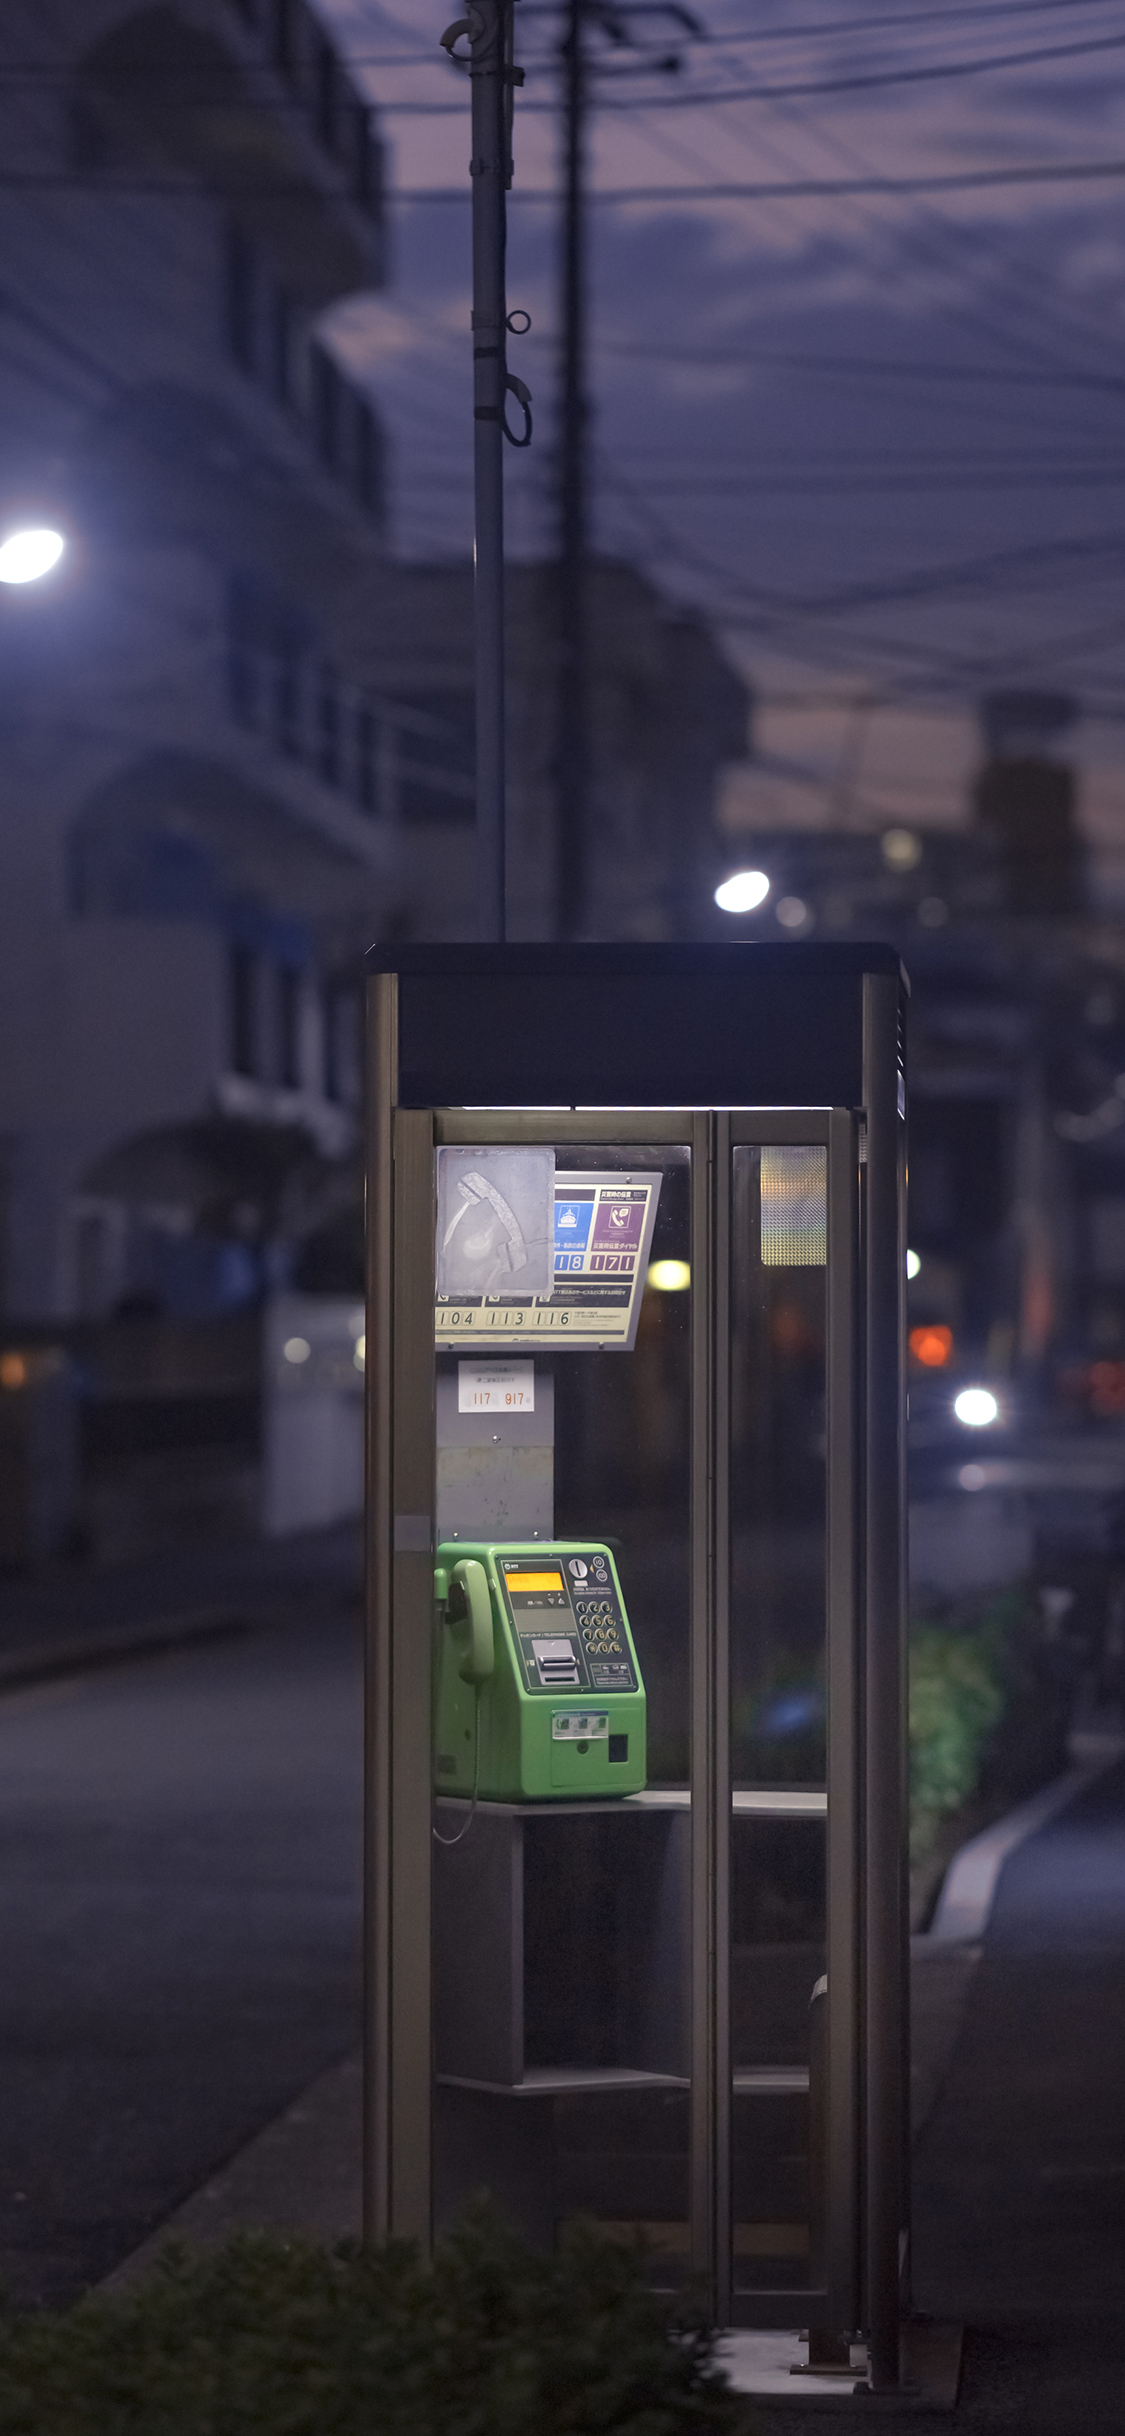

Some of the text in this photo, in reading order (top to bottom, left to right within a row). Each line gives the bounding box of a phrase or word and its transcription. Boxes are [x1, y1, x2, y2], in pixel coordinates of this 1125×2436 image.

[594, 1256, 630, 1270] 171
[440, 1312, 472, 1325] 104
[491, 1312, 523, 1325] 113
[536, 1312, 568, 1325] 116
[474, 1392, 523, 1405] 117 917
